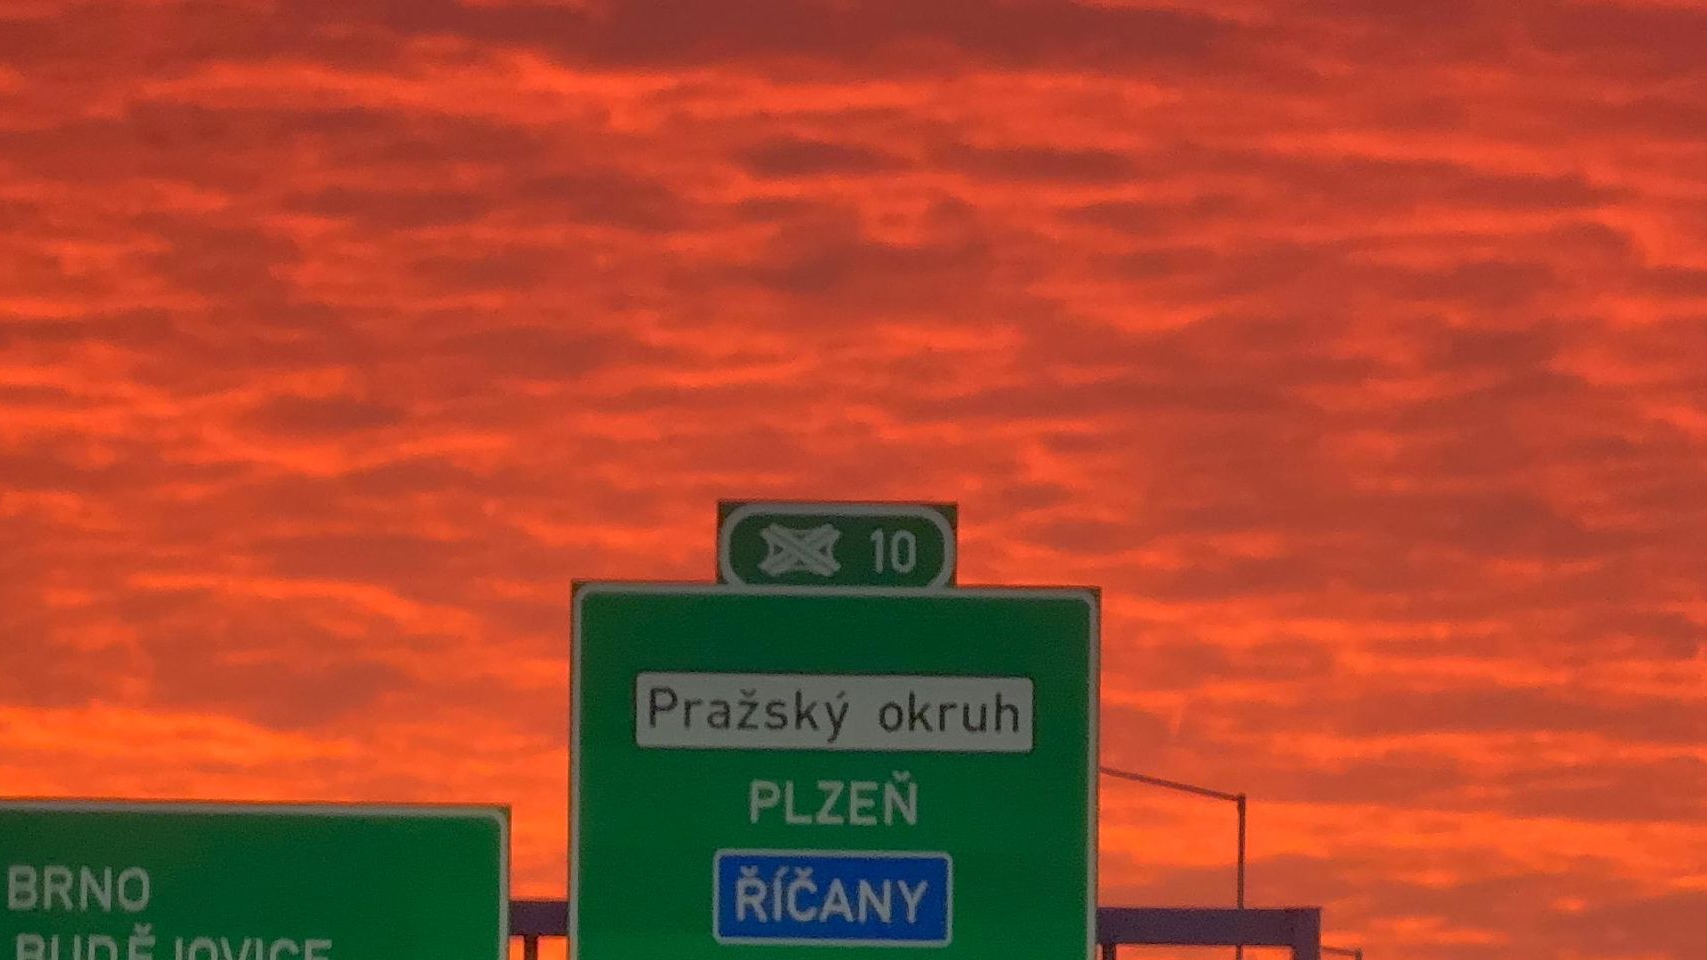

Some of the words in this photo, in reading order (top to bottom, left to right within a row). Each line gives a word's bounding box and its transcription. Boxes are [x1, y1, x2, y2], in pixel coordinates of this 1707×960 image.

[870, 528, 917, 575] 10
[647, 686, 850, 744] Pražský
[879, 691, 1022, 735] okruh
[749, 770, 919, 826] PLZEŇ
[7, 865, 152, 912] BRNO
[735, 864, 929, 926] ŘÍČANY
